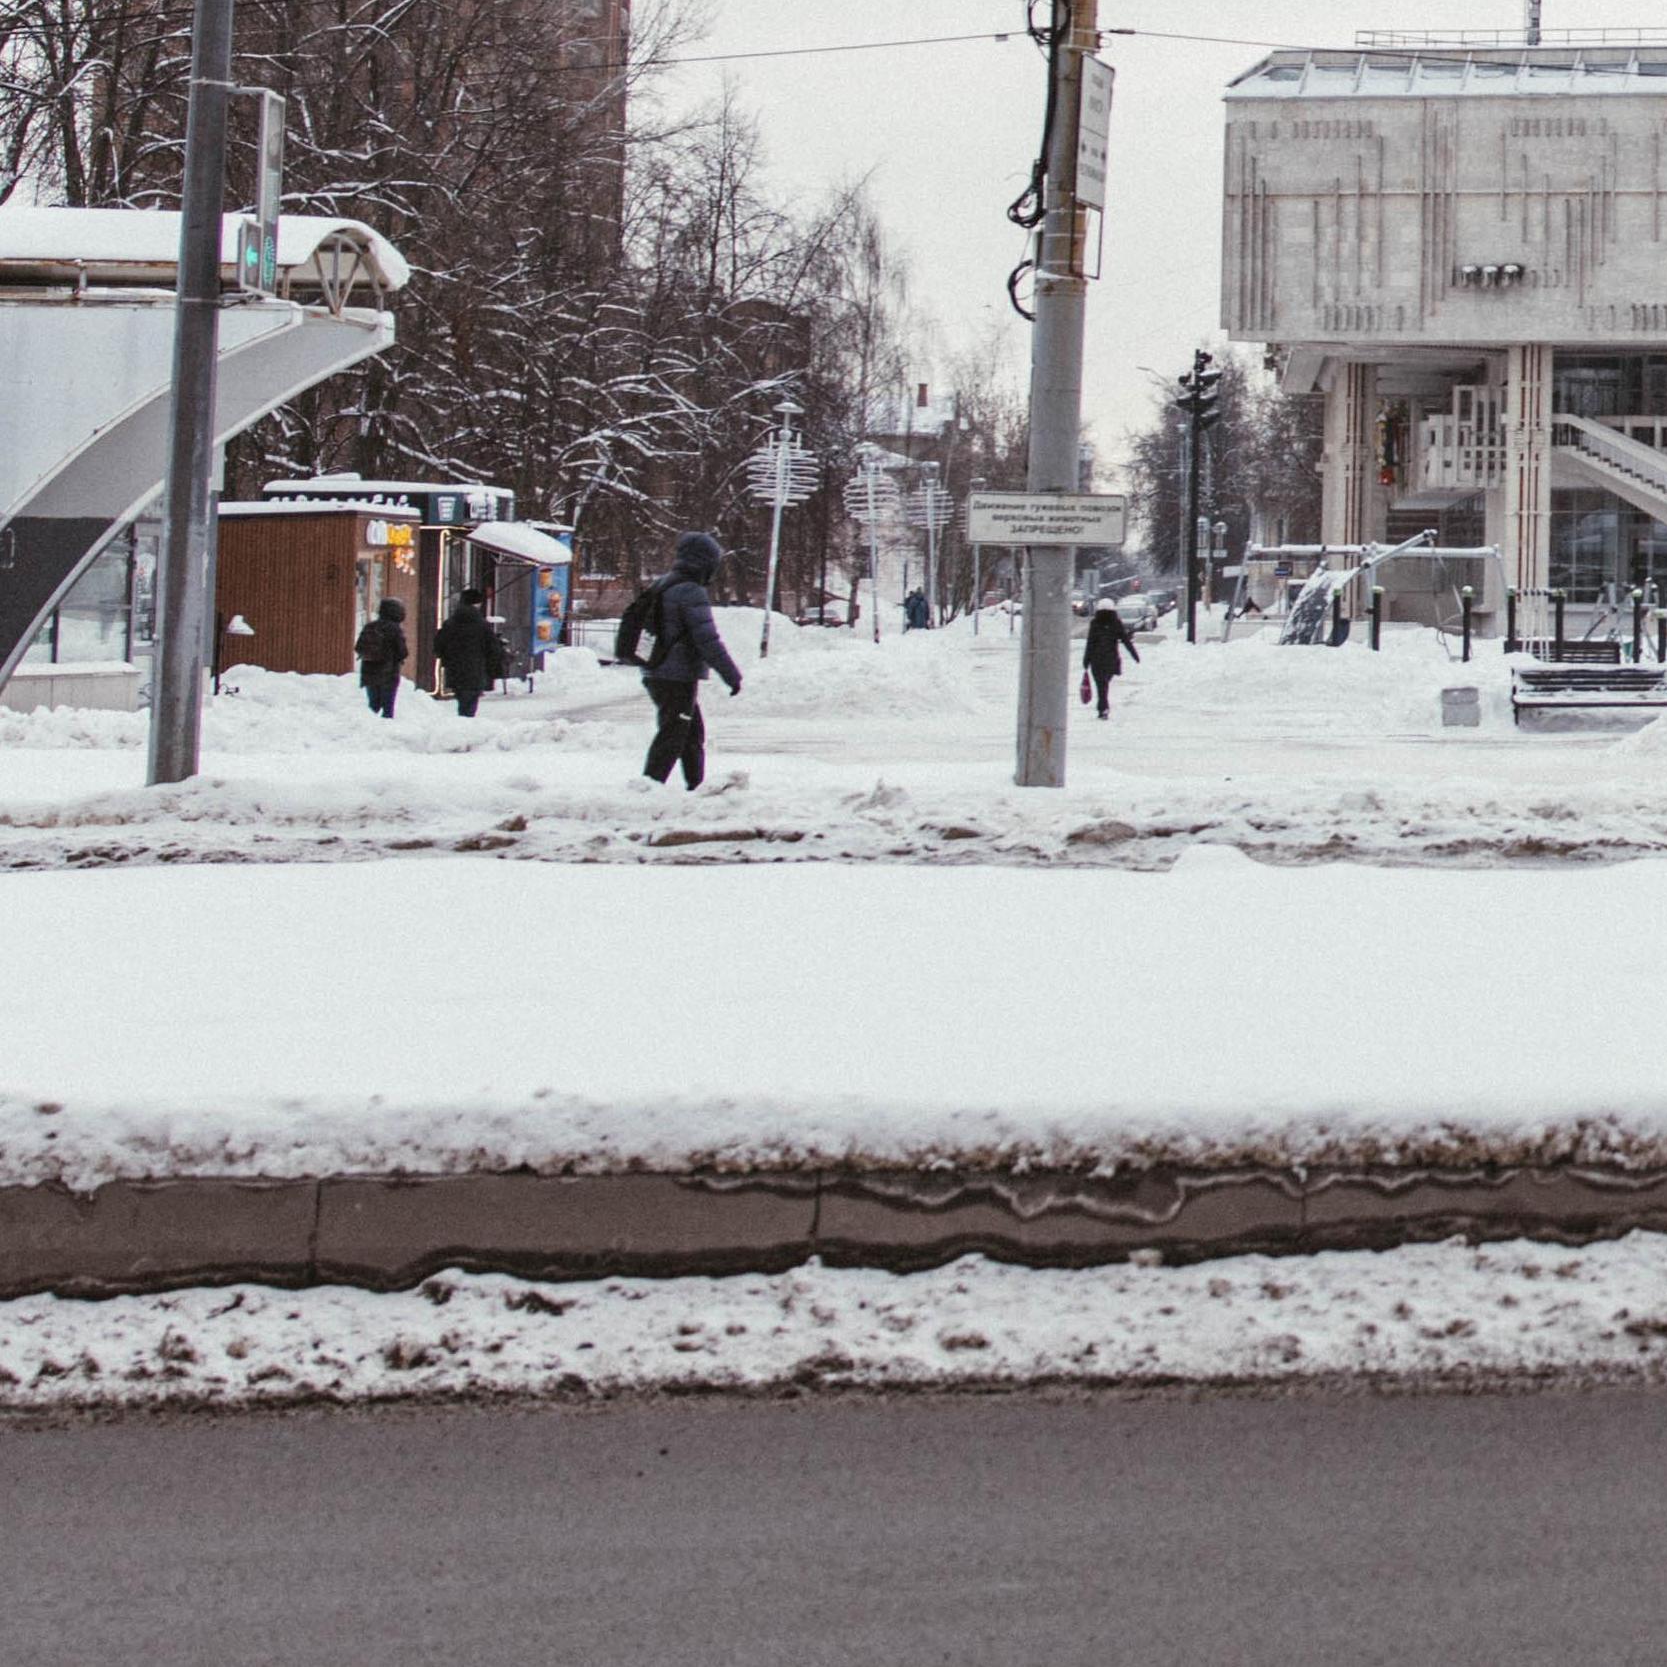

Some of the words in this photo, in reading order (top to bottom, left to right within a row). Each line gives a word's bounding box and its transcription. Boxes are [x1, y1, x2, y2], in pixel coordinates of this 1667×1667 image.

[973, 500, 1027, 511] Движение
[1030, 503, 1076, 513] гужевых
[1081, 504, 1121, 512] повозок
[992, 513, 1044, 523] верховых
[1049, 514, 1102, 523] животных
[1010, 525, 1084, 535] ЗАПРЕЩЕНО!
